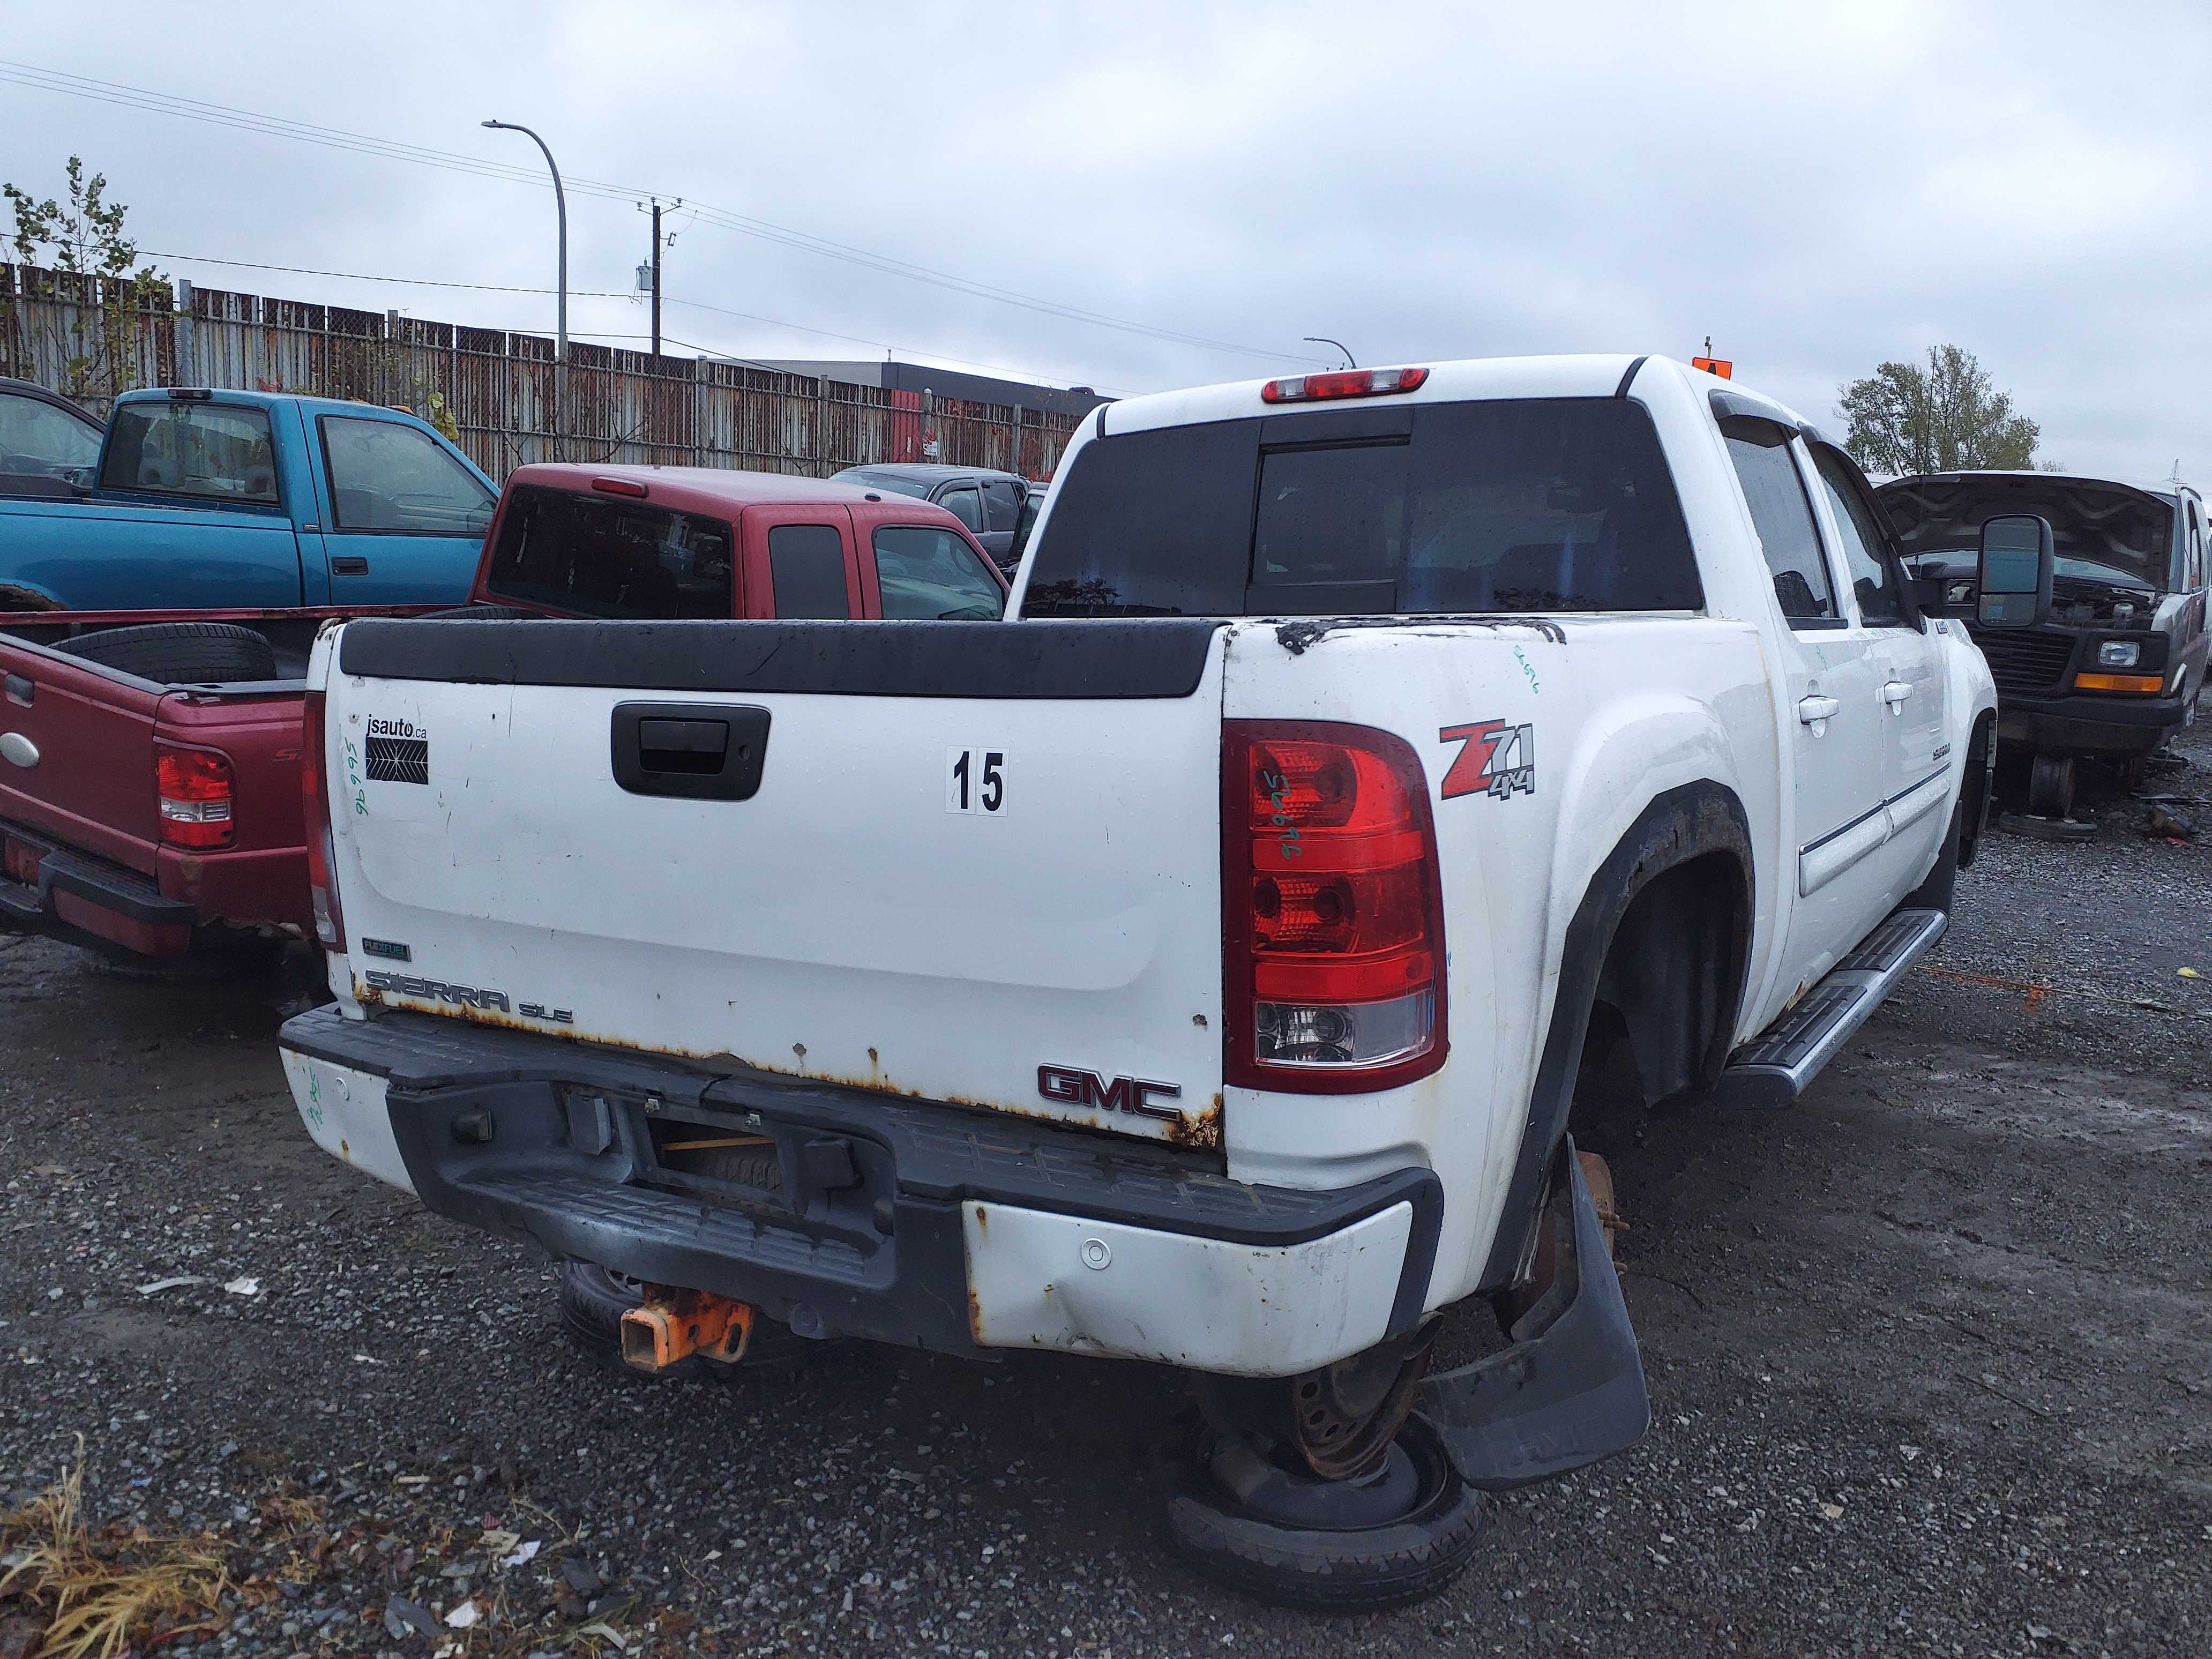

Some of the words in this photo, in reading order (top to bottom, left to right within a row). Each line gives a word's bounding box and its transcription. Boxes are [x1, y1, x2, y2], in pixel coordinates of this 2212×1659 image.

[366, 714, 427, 739] jsauto.ca
[345, 737, 369, 816] 56696
[954, 751, 1003, 812] 15
[1439, 718, 1534, 800] Z71
[1262, 770, 1303, 860] 56696
[365, 969, 510, 1012] SIERRA
[518, 1003, 573, 1023] SLE
[1037, 1063, 1181, 1122] GMC
